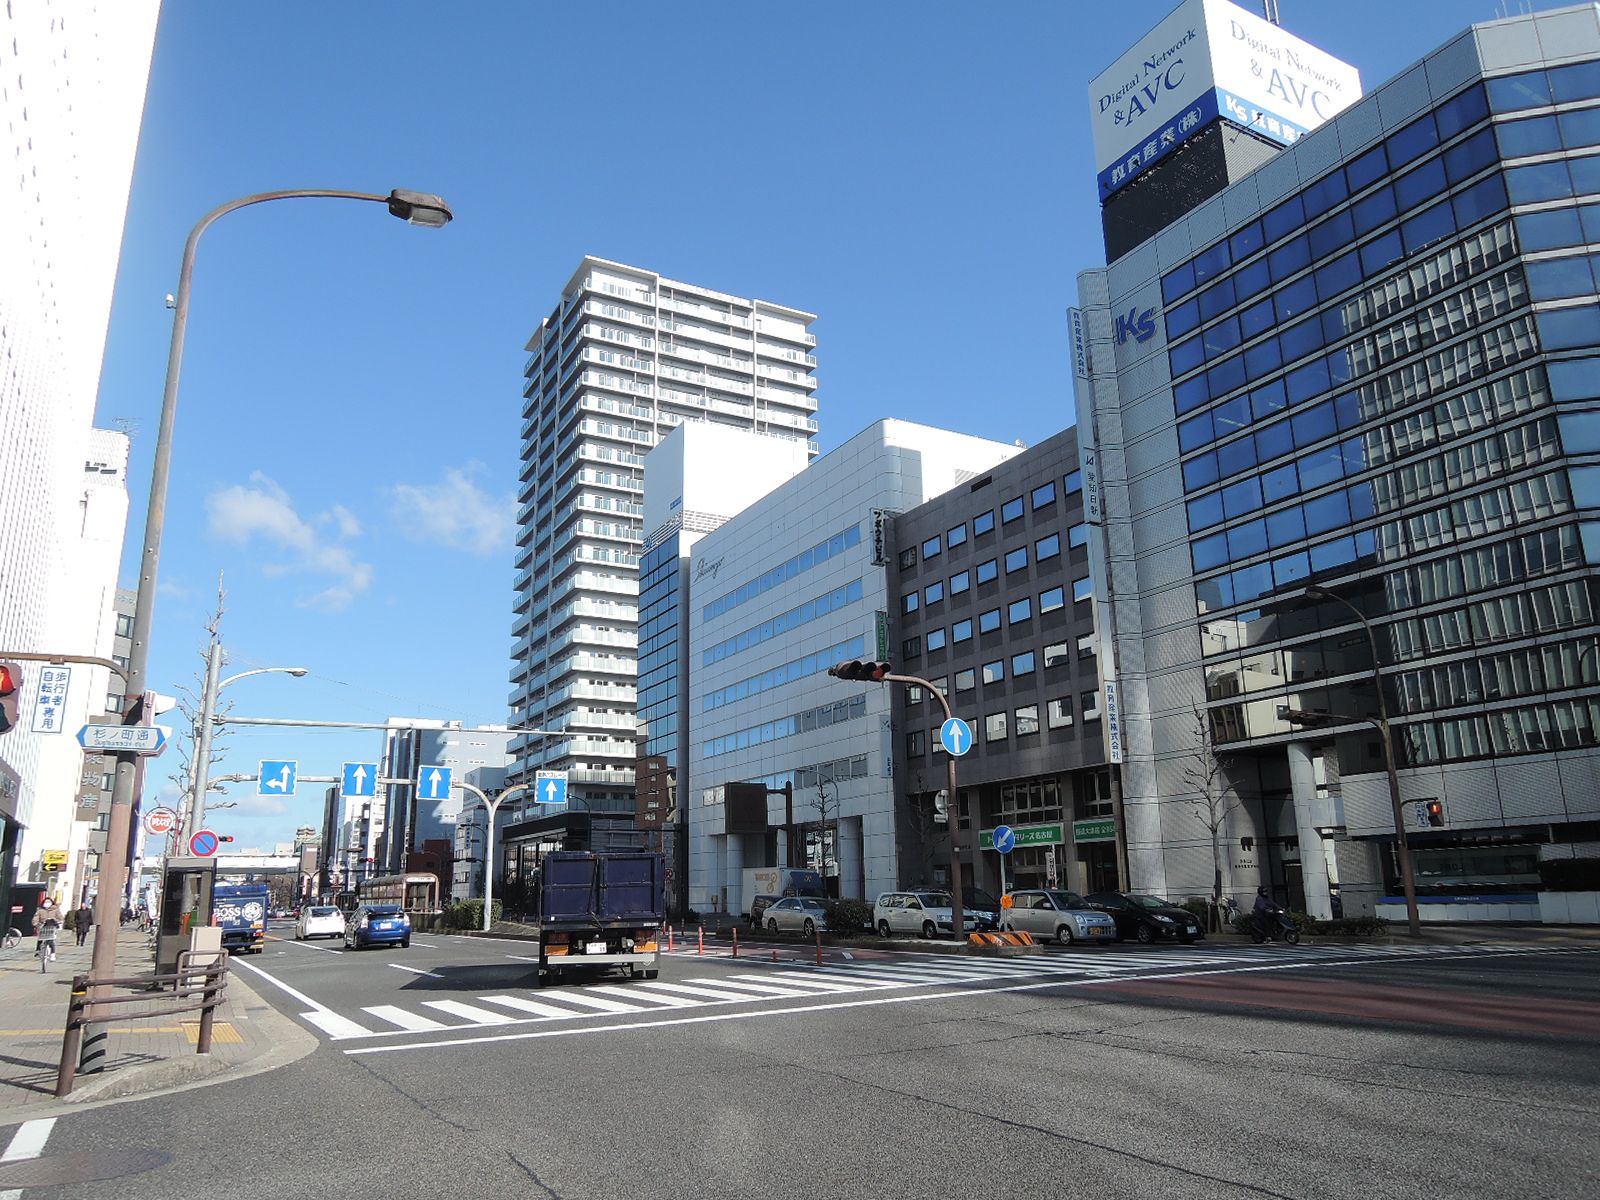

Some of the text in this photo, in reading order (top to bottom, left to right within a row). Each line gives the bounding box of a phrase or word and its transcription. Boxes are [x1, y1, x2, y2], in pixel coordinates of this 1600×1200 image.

[1099, 28, 1197, 113] Digital Network
[1230, 20, 1343, 93] Digital Network
[1250, 58, 1264, 80] &
[1114, 59, 1186, 128] & AVC
[93, 729, 150, 741] 杉ノ町通
